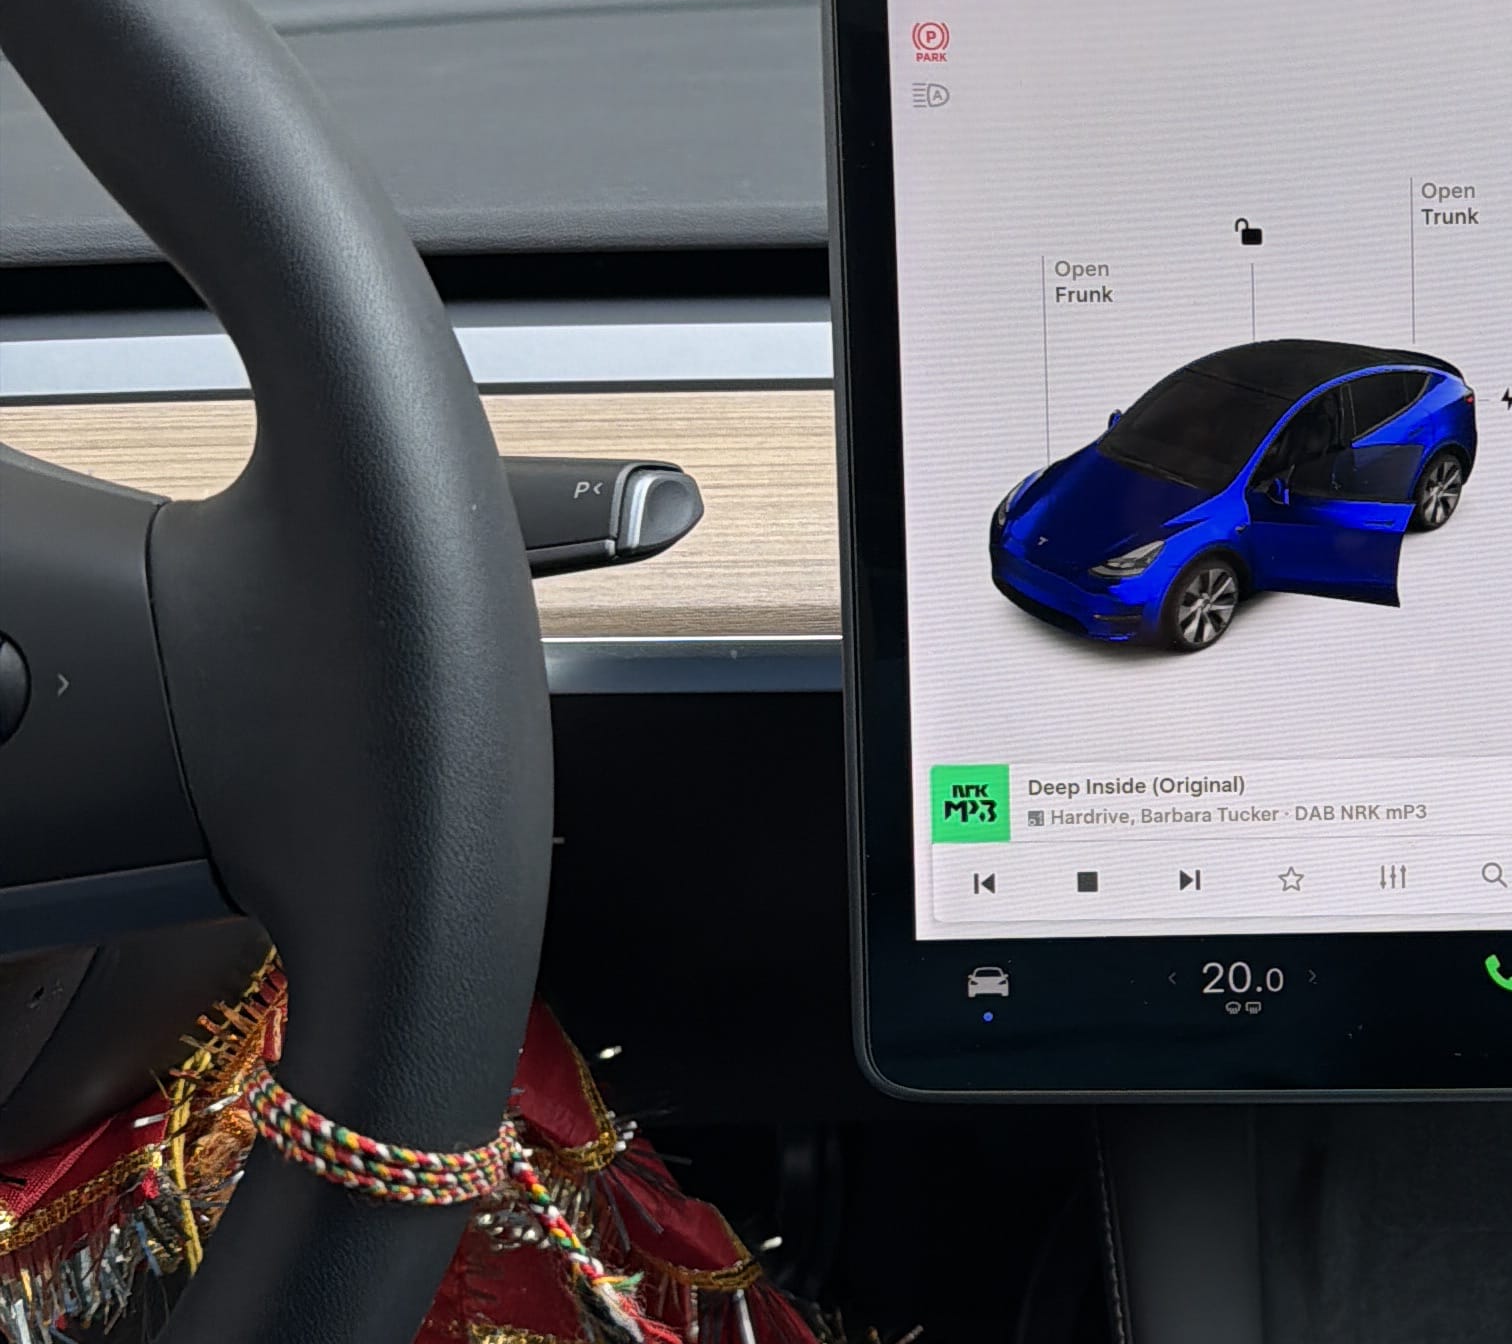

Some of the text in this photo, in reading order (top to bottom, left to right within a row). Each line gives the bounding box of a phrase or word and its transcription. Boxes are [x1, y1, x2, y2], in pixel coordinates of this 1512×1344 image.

[916, 53, 948, 62] PARK
[1421, 183, 1476, 201] Open
[1421, 209, 1479, 225] Trunk
[1055, 261, 1110, 279] Open
[1055, 286, 1113, 302] Frunk
[573, 481, 591, 499] P
[1028, 775, 1246, 799] Deep Inside (Original)
[1051, 804, 1428, 826] Hardrive, Barbara Tucker DAB NRK mP3
[1202, 961, 1285, 994] 20.0
